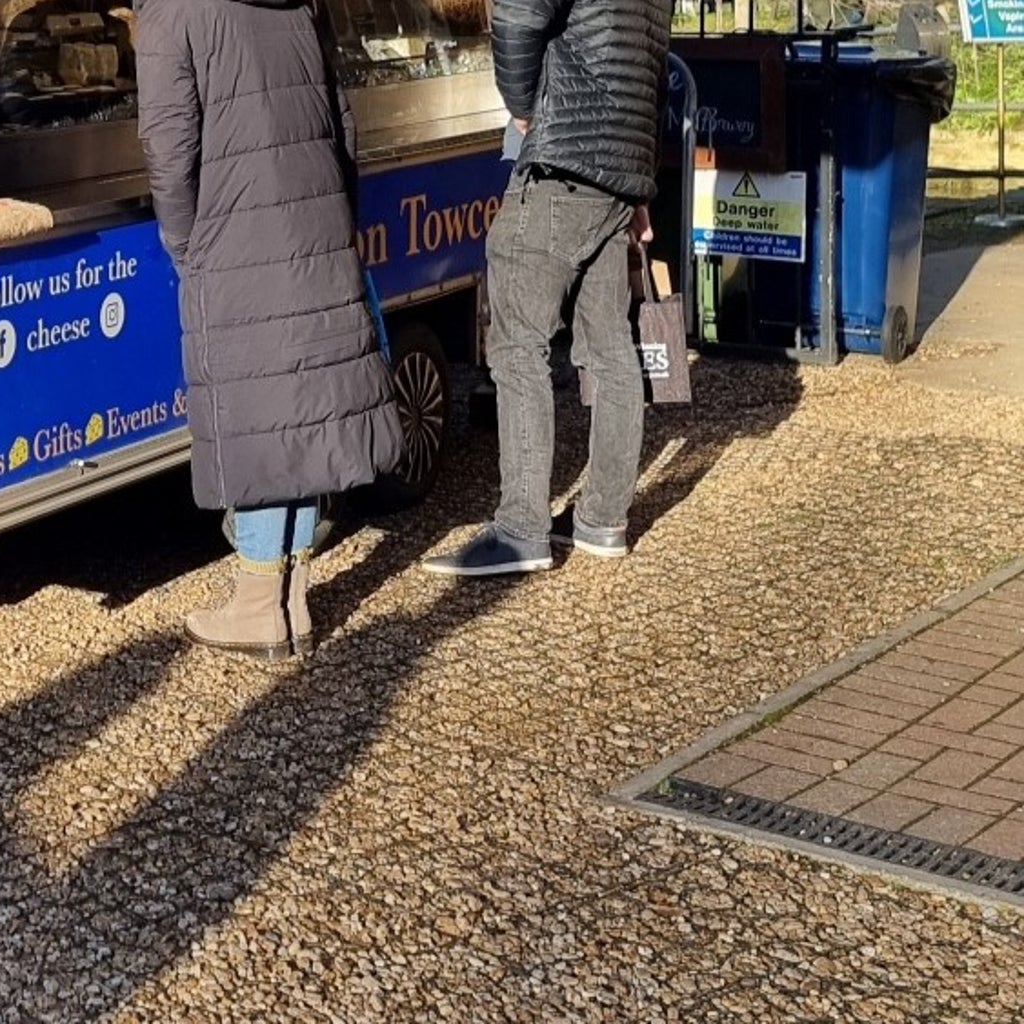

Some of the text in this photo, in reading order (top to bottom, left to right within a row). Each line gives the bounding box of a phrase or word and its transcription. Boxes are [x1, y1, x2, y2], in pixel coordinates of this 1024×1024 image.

[399, 193, 504, 256] Towce
[713, 216, 780, 231] Deep water
[716, 199, 776, 219] Danger
[48, 272, 70, 296] us
[75, 258, 104, 290] for
[107, 250, 138, 282] the
[26, 317, 90, 352] cheese
[32, 422, 82, 462] Gifts
[106, 401, 167, 440] Events
[171, 388, 188, 416] &
